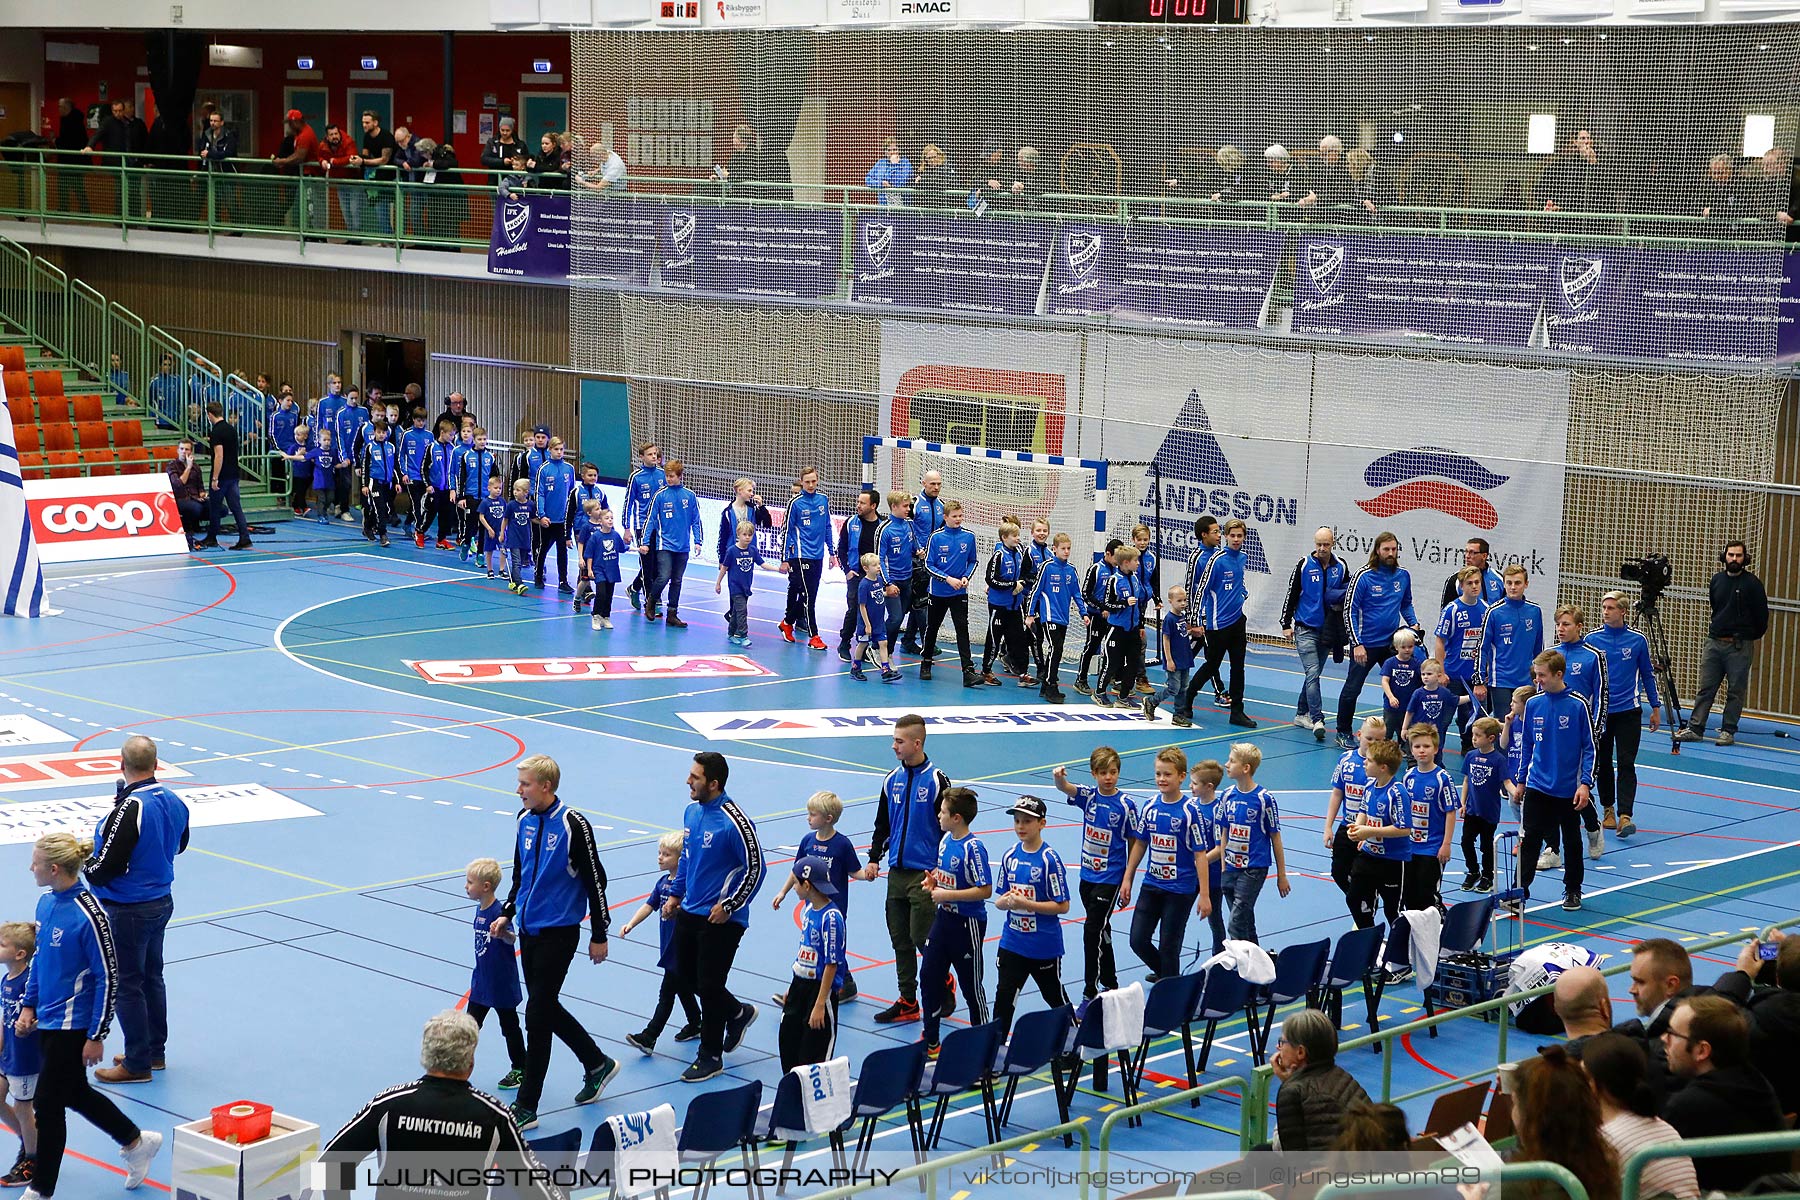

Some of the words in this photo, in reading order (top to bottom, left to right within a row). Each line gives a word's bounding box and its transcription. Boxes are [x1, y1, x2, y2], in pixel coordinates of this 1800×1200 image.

[662, 5, 674, 18] as
[676, 4, 684, 17] it
[686, 4, 696, 17] is
[726, 4, 761, 12] Riksbyggen
[507, 212, 526, 230] SKÖVDE
[496, 242, 528, 256] Handboll
[860, 268, 894, 283] Handboll
[1059, 280, 1098, 294] Handboll
[1302, 293, 1345, 312] Handboll
[1548, 309, 1598, 326] Handboll
[41, 500, 154, 536] coop
[1456, 611, 1469, 622] 25
[435, 660, 757, 678] JULA
[820, 712, 1162, 728] Mresjöhus
[1536, 733, 1543, 741] FS
[1343, 762, 1355, 773] 23
[1346, 786, 1364, 796] MAX
[1146, 808, 1158, 821] 41
[1413, 804, 1428, 813] AXI
[112, 798, 132, 834] SALMING
[570, 810, 590, 843] SALMING
[738, 816, 756, 852] SALMING
[1086, 827, 1110, 842] MAXI
[1152, 835, 1175, 847] MAXI
[802, 865, 811, 878] 3
[1150, 866, 1176, 878] DALOC
[80, 892, 97, 914] LMING
[96, 914, 112, 957] SALMING
[799, 949, 815, 961] AXI
[397, 1116, 482, 1139] FUNKTIONÄR
